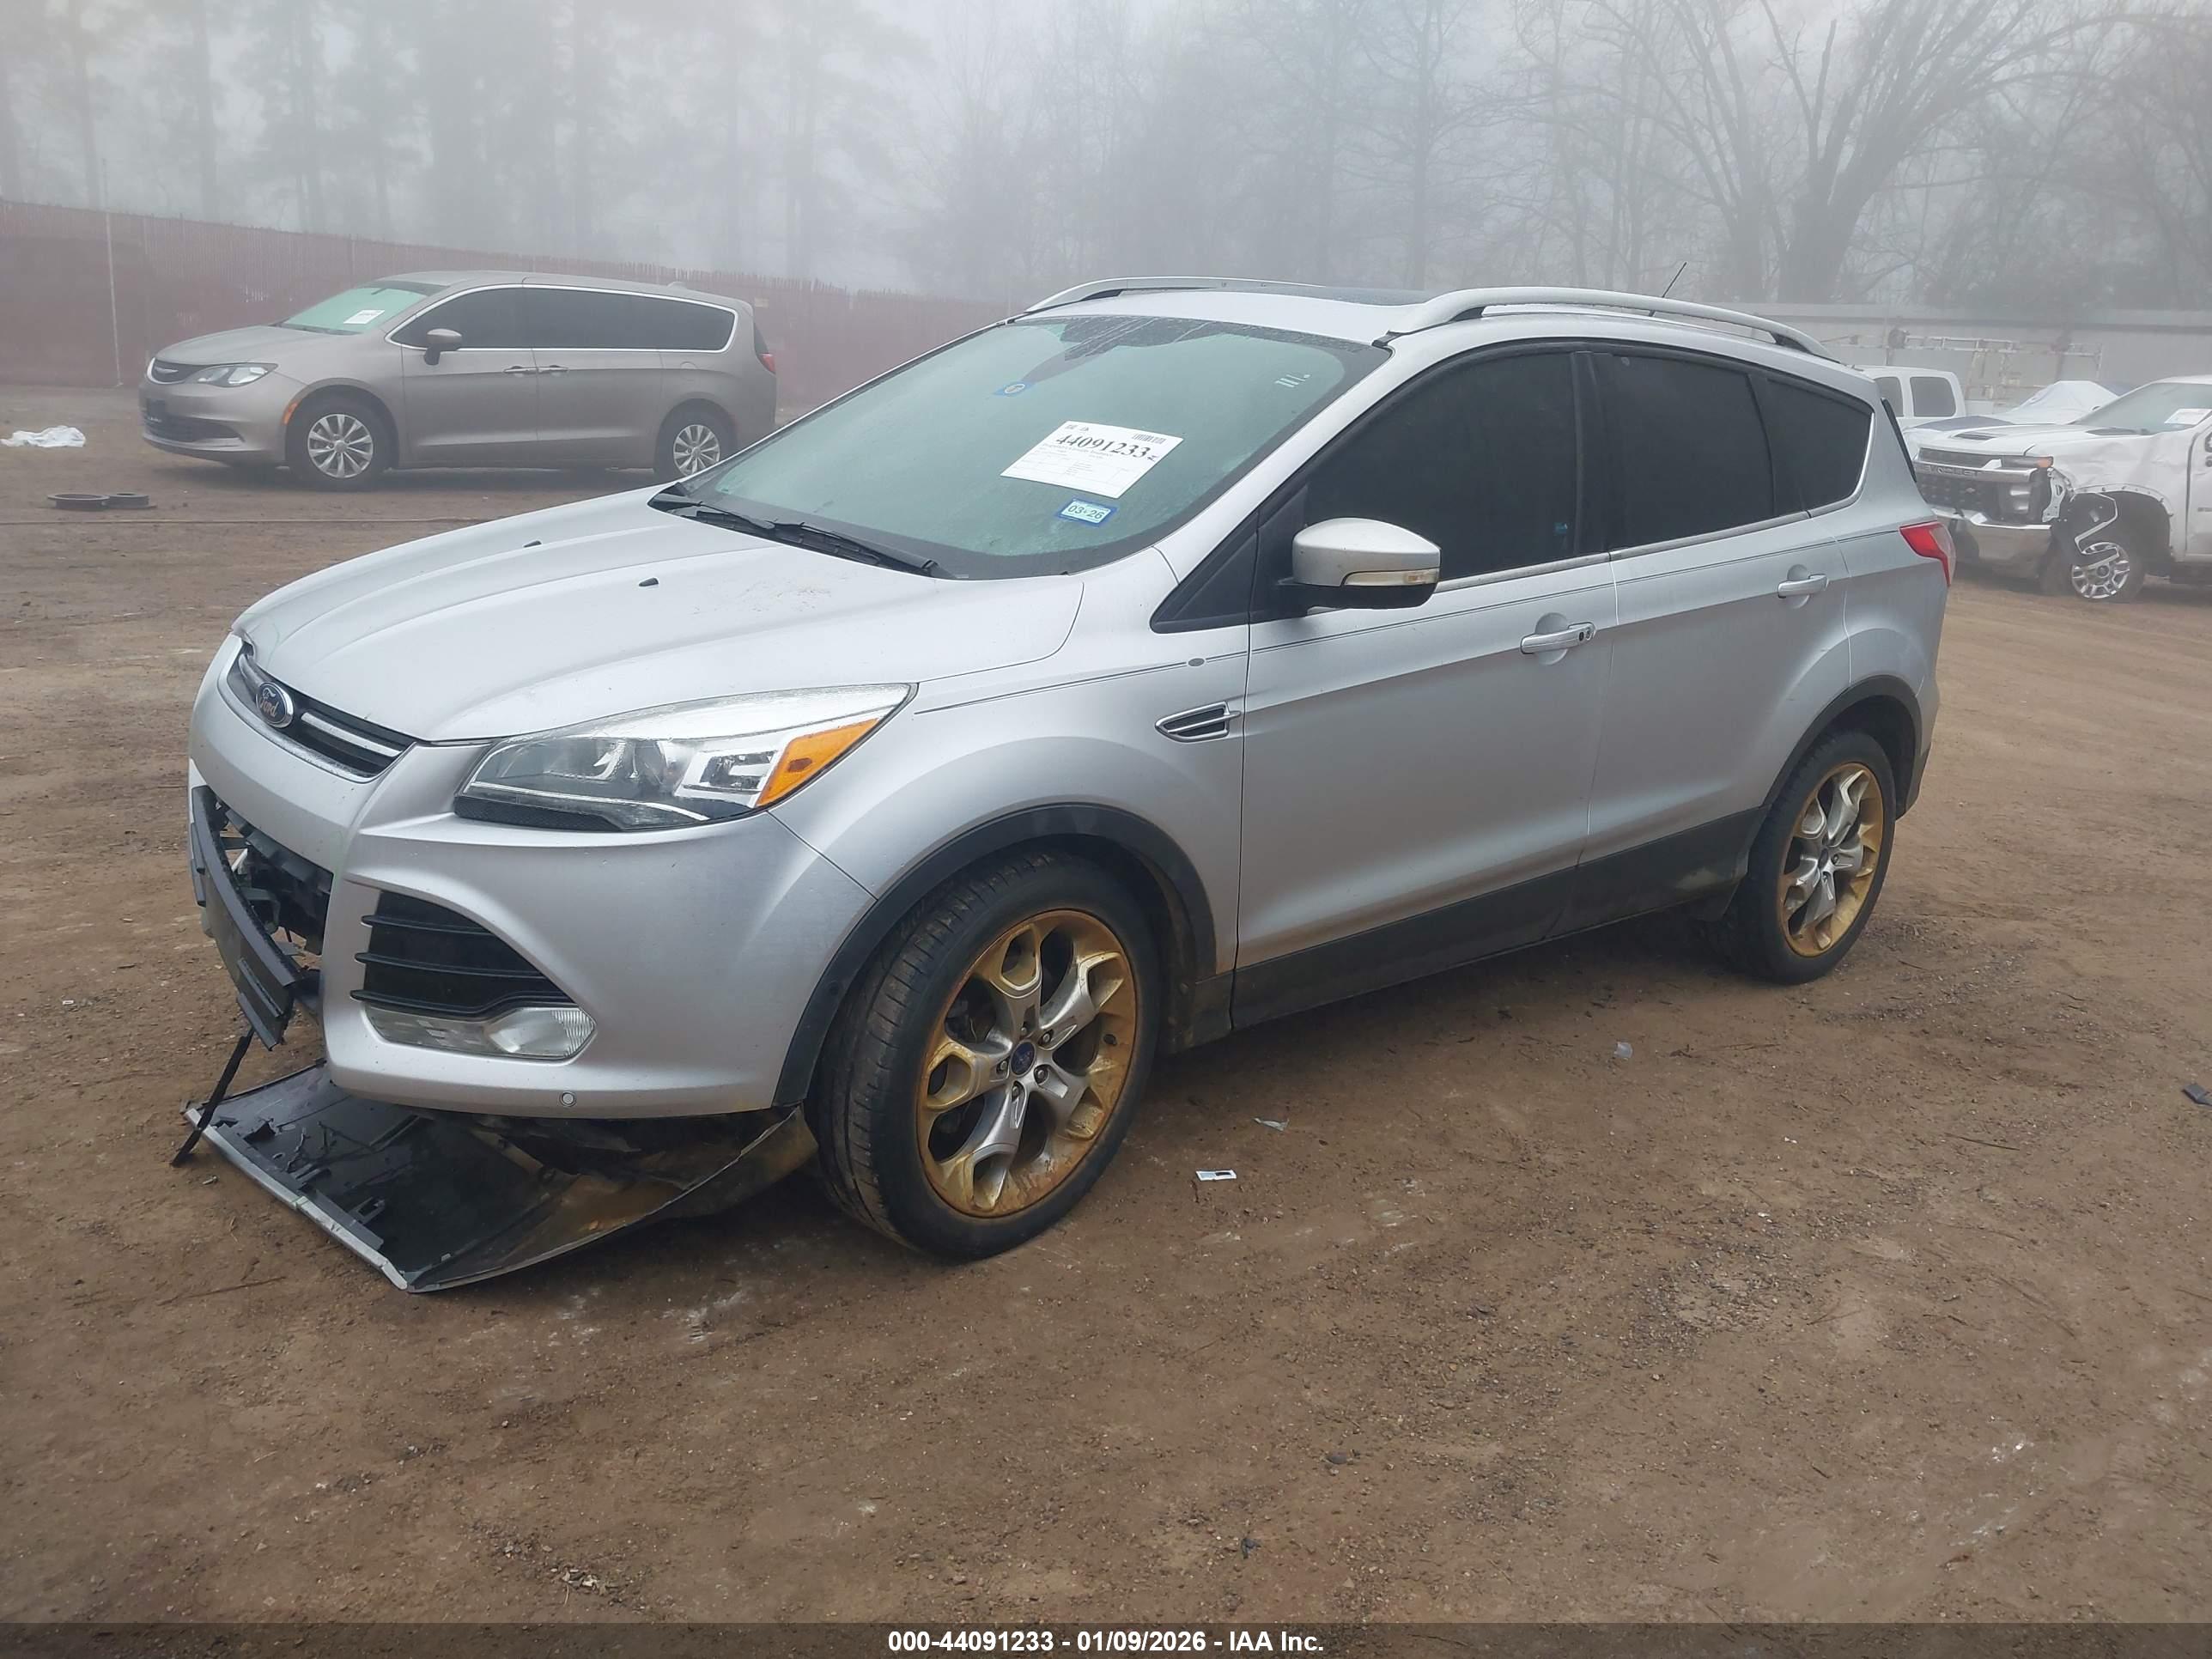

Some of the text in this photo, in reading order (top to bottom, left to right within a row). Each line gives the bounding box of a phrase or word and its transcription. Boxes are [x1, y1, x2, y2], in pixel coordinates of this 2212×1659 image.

[1055, 434, 1152, 459] 44091233
[1067, 505, 1105, 520] 03 26
[259, 687, 279, 718] Ford
